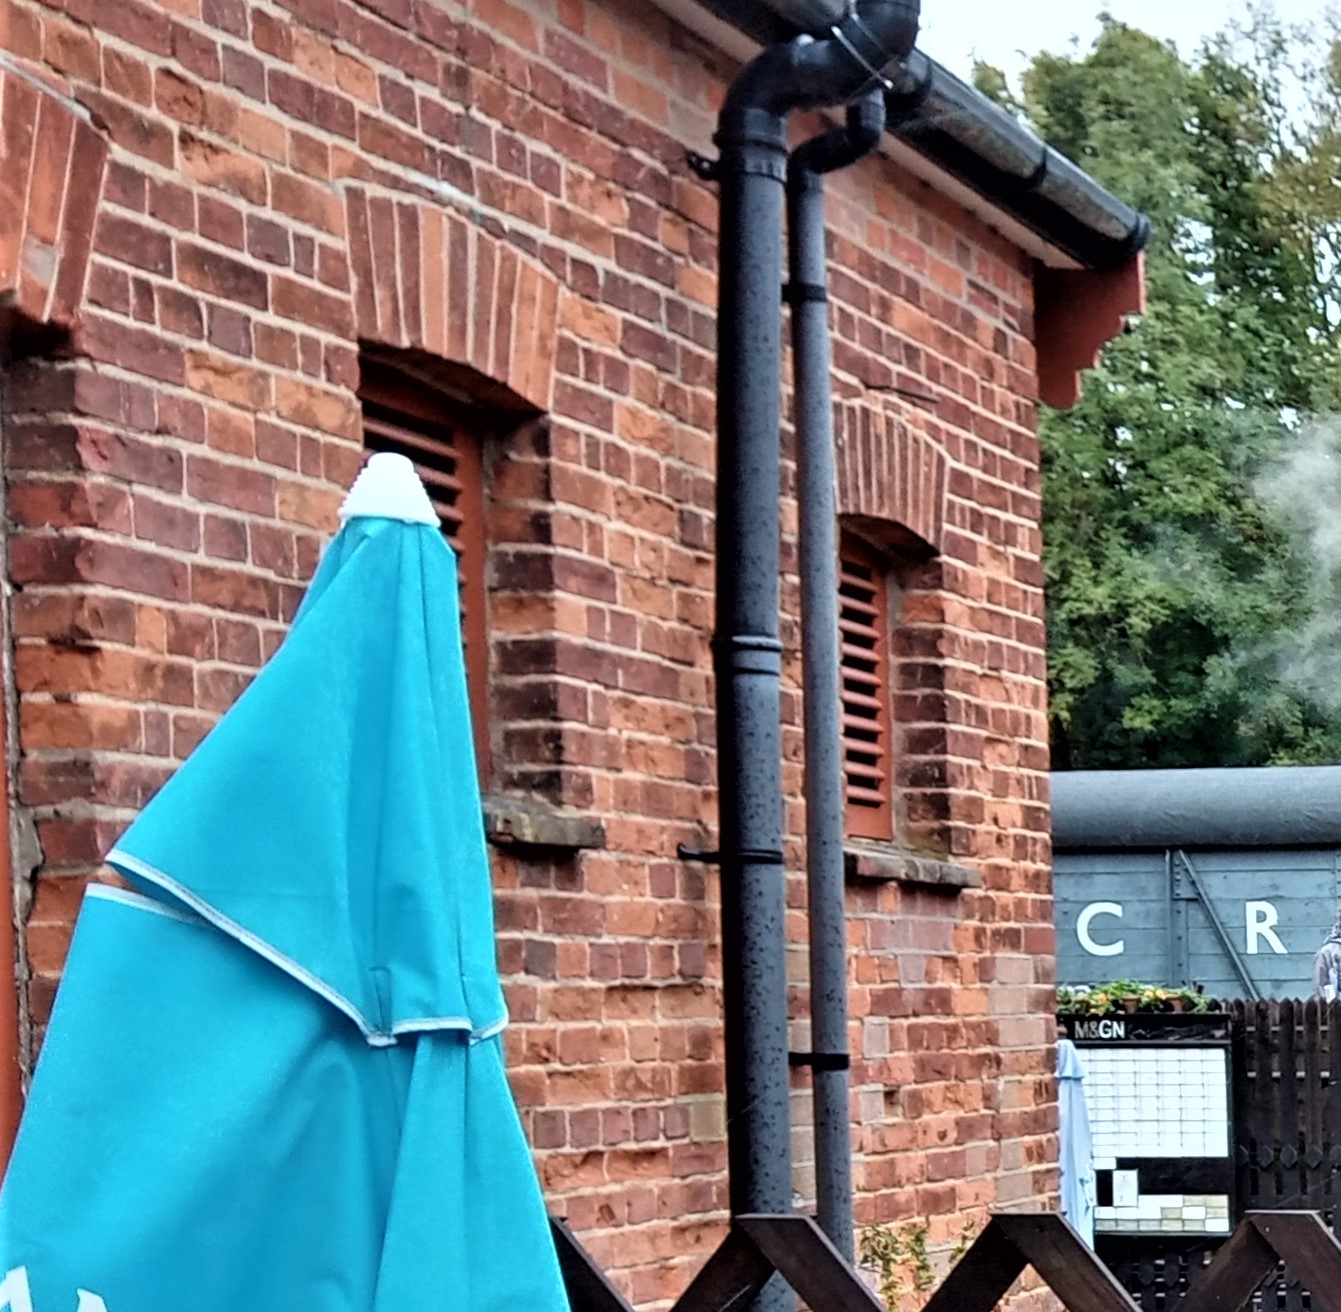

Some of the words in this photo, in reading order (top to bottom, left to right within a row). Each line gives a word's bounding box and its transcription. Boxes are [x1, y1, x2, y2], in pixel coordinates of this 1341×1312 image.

[1076, 902, 1124, 955] C
[1246, 901, 1288, 955] R
[1074, 1019, 1126, 1039] M&GN
